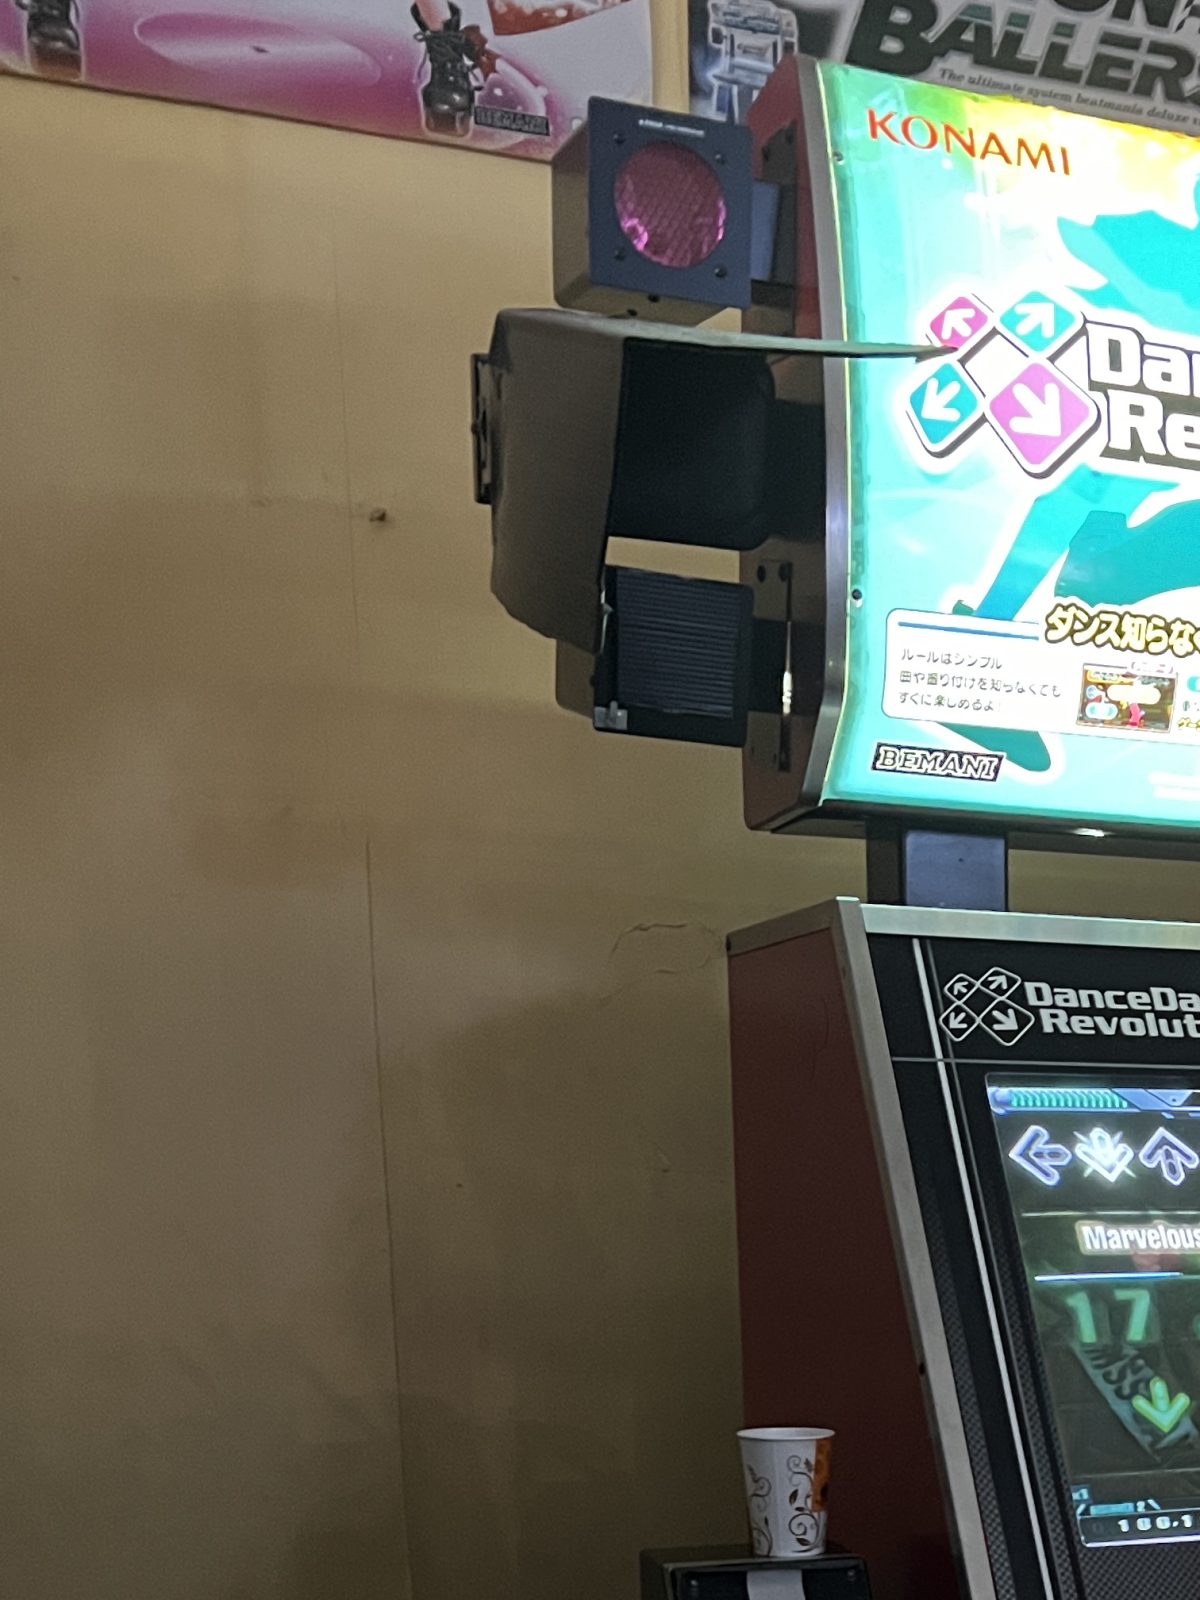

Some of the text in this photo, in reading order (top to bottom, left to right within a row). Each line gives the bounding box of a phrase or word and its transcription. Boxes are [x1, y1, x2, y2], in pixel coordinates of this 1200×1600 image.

[938, 67, 967, 84] The
[968, 72, 1024, 95] ultimate
[1027, 83, 1073, 103] system
[867, 108, 1070, 176] KONAMI
[876, 745, 1000, 780] BEMANI
